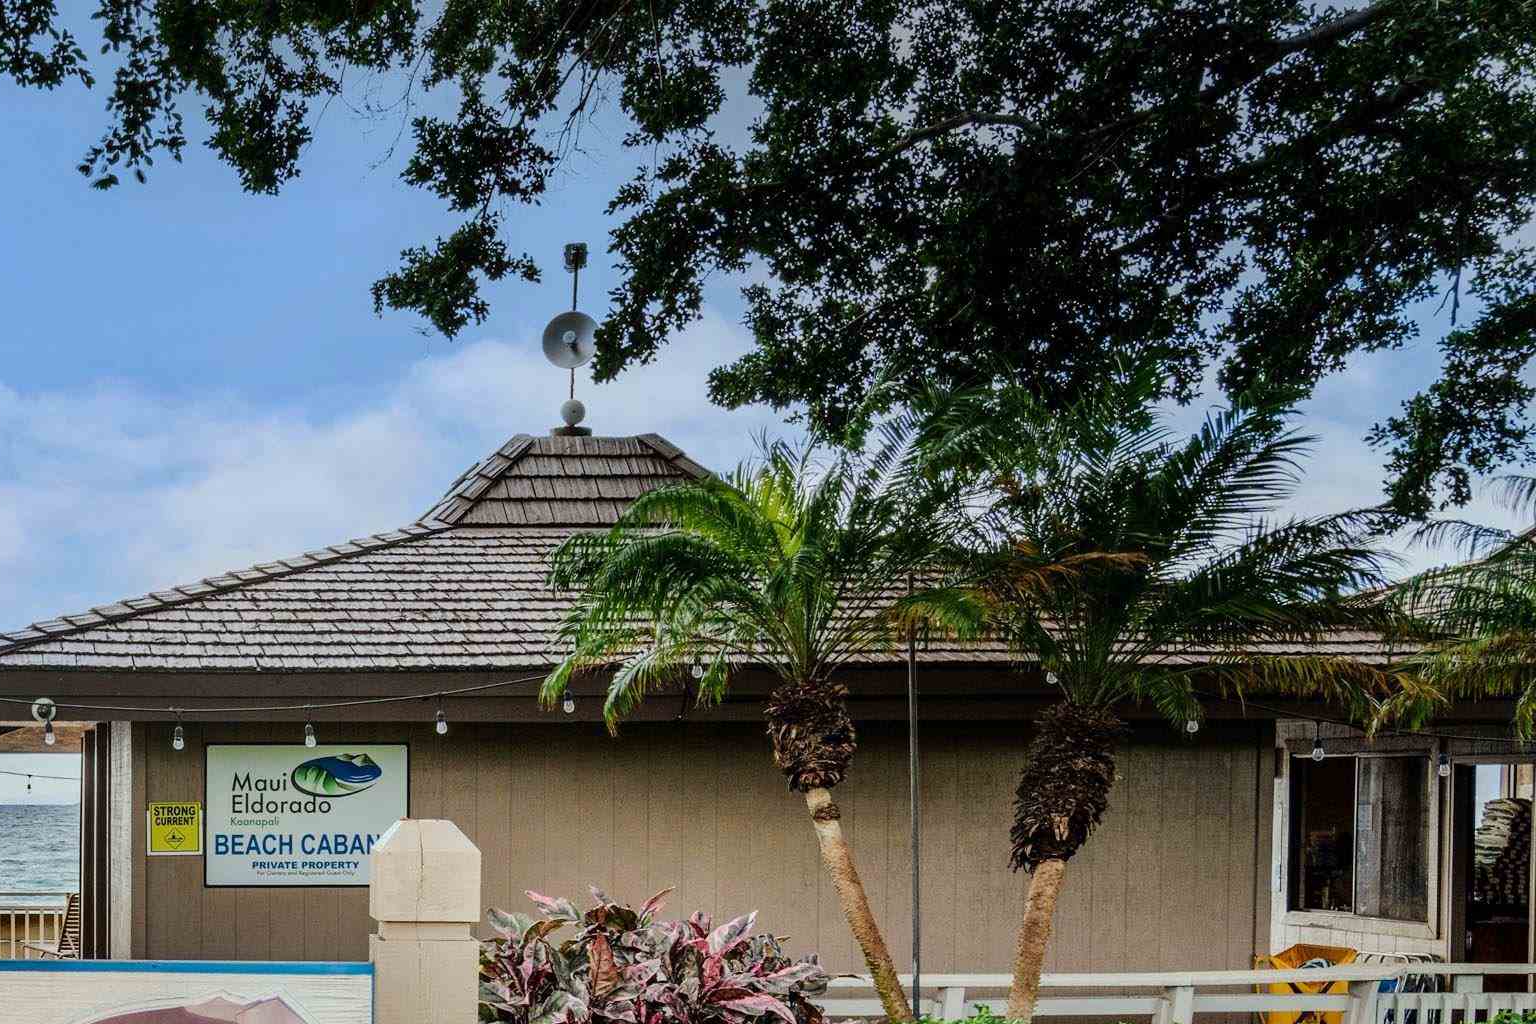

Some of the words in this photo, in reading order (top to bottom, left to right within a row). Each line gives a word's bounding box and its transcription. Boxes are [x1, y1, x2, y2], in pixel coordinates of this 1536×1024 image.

[231, 772, 287, 792] Maui
[231, 793, 332, 814] Eldorado
[153, 806, 196, 816] STRONG
[155, 816, 194, 826] CURRENT
[230, 816, 280, 829] Kaanapali
[214, 834, 293, 856] BEACH
[300, 834, 380, 856] CABAN
[252, 861, 298, 870] PRIVATE
[301, 861, 360, 870] PROPERTY
